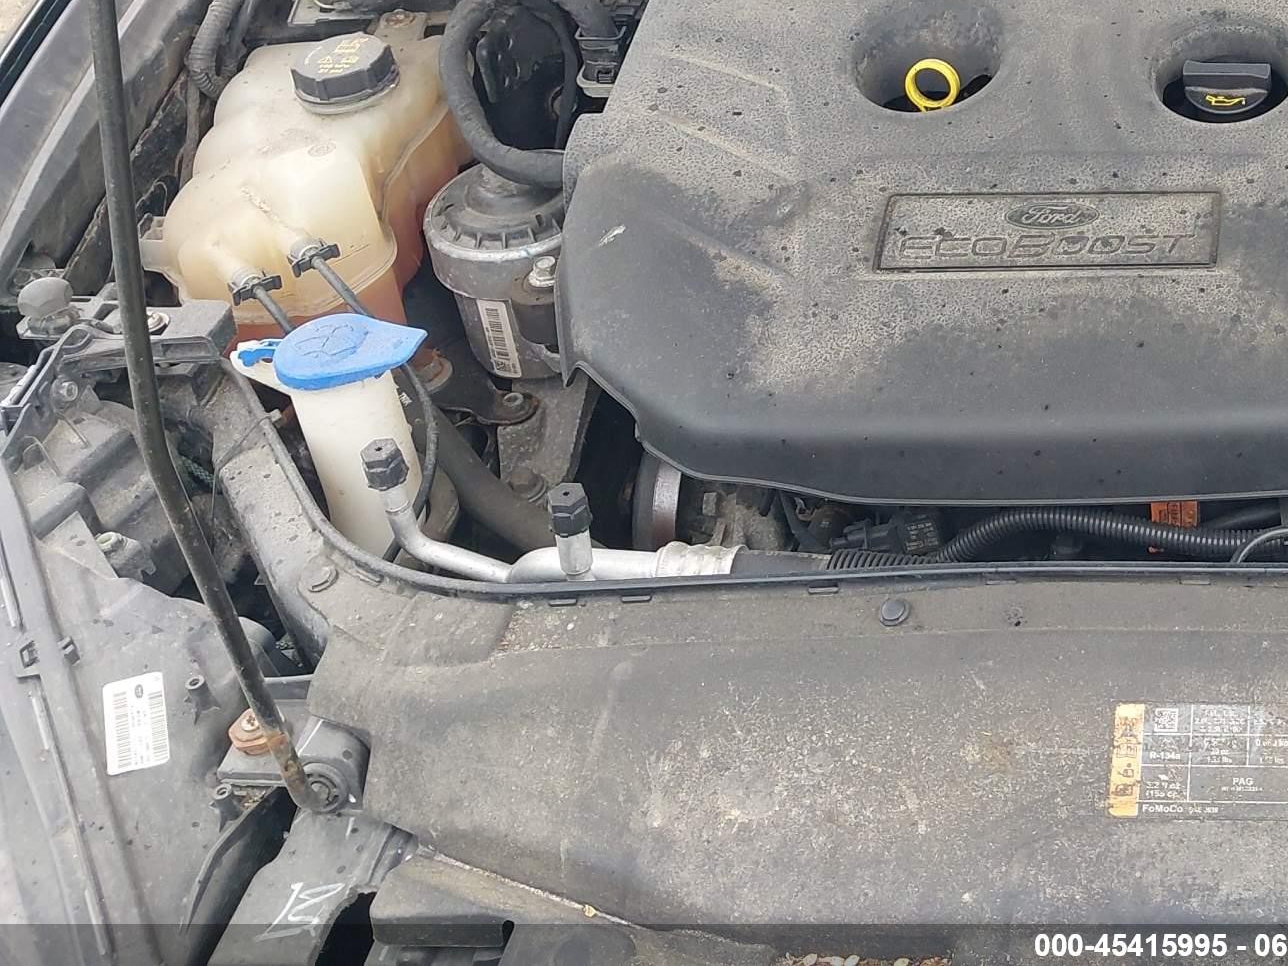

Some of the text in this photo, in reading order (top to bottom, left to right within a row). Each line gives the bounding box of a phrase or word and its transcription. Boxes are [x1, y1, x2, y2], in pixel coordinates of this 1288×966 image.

[1012, 203, 1095, 227] Ford
[1232, 777, 1255, 786] PAG
[1142, 803, 1184, 814] FoMoCo
